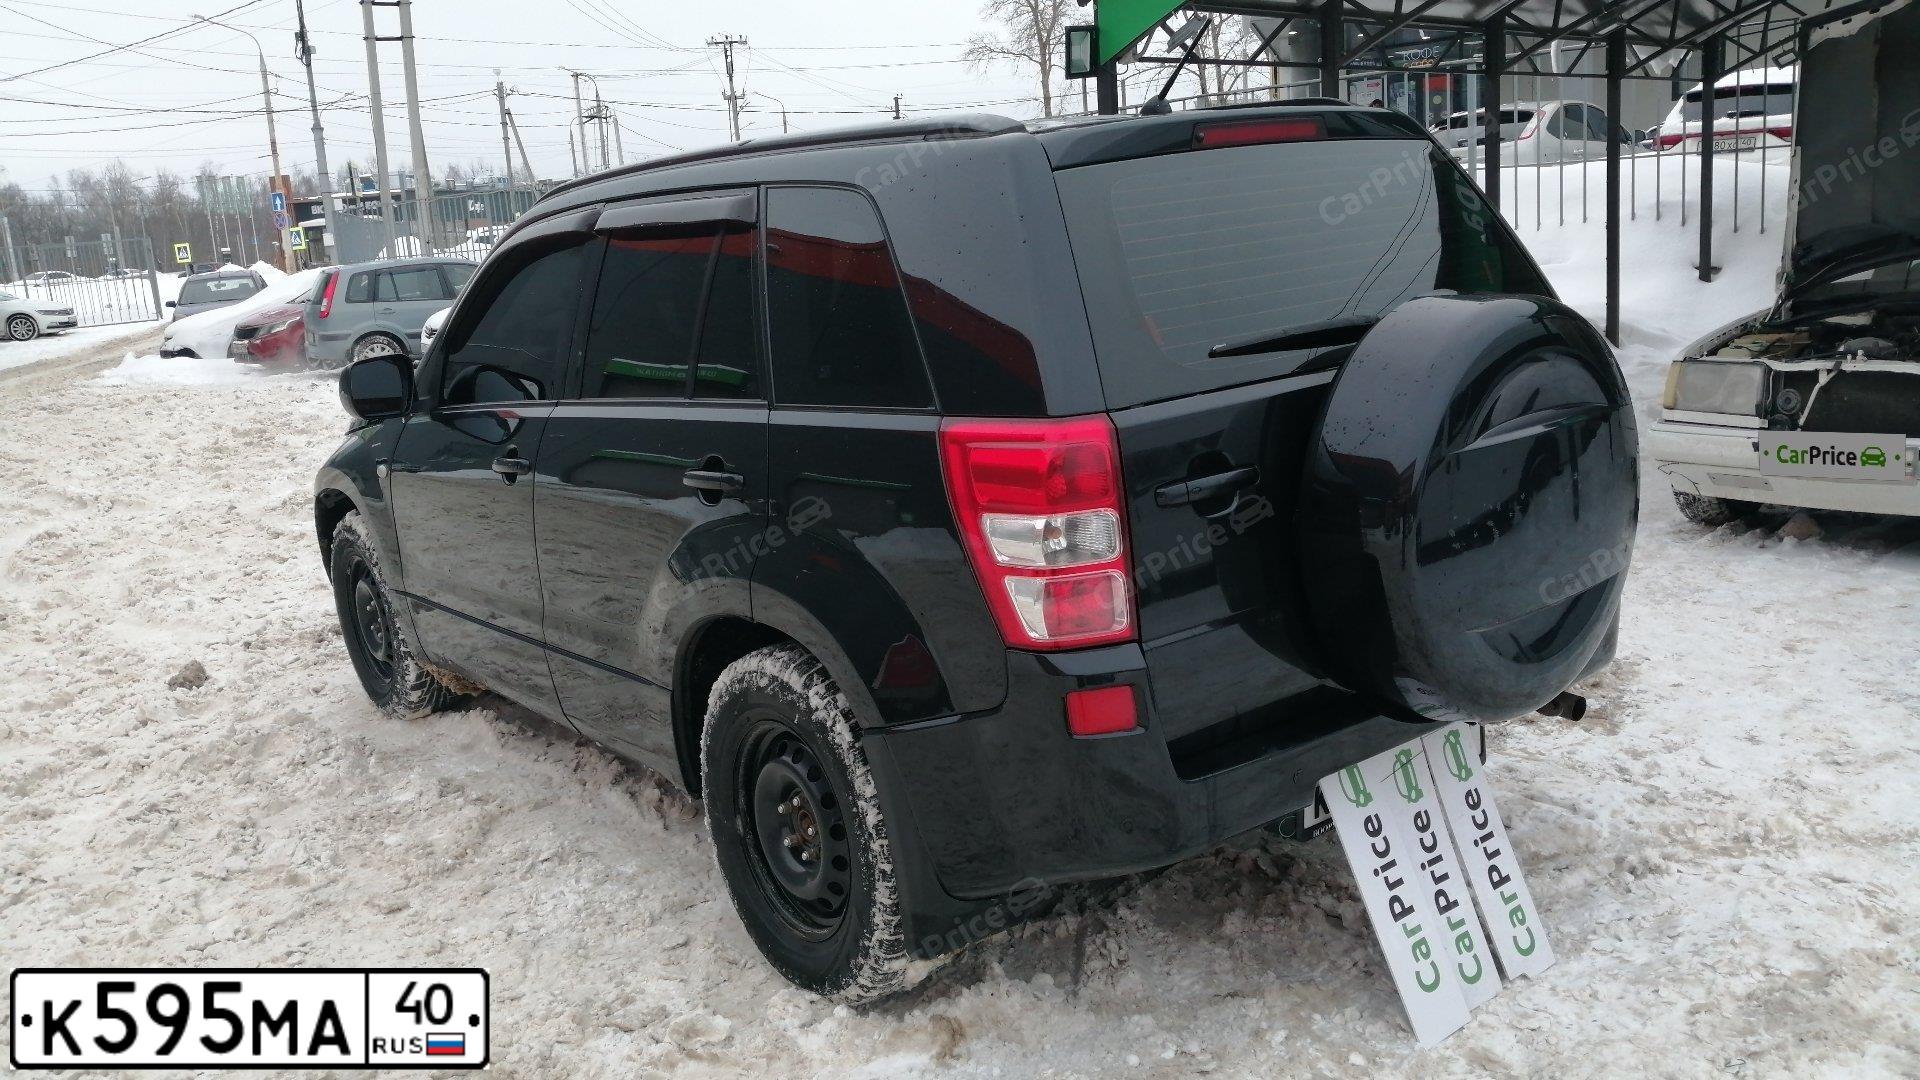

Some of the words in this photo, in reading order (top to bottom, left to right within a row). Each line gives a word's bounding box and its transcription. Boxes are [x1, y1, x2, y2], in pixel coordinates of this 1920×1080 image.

[1363, 812, 1441, 994] CarPrice
[1412, 808, 1483, 985] CarPrice
[1463, 787, 1537, 957] CarPrice
